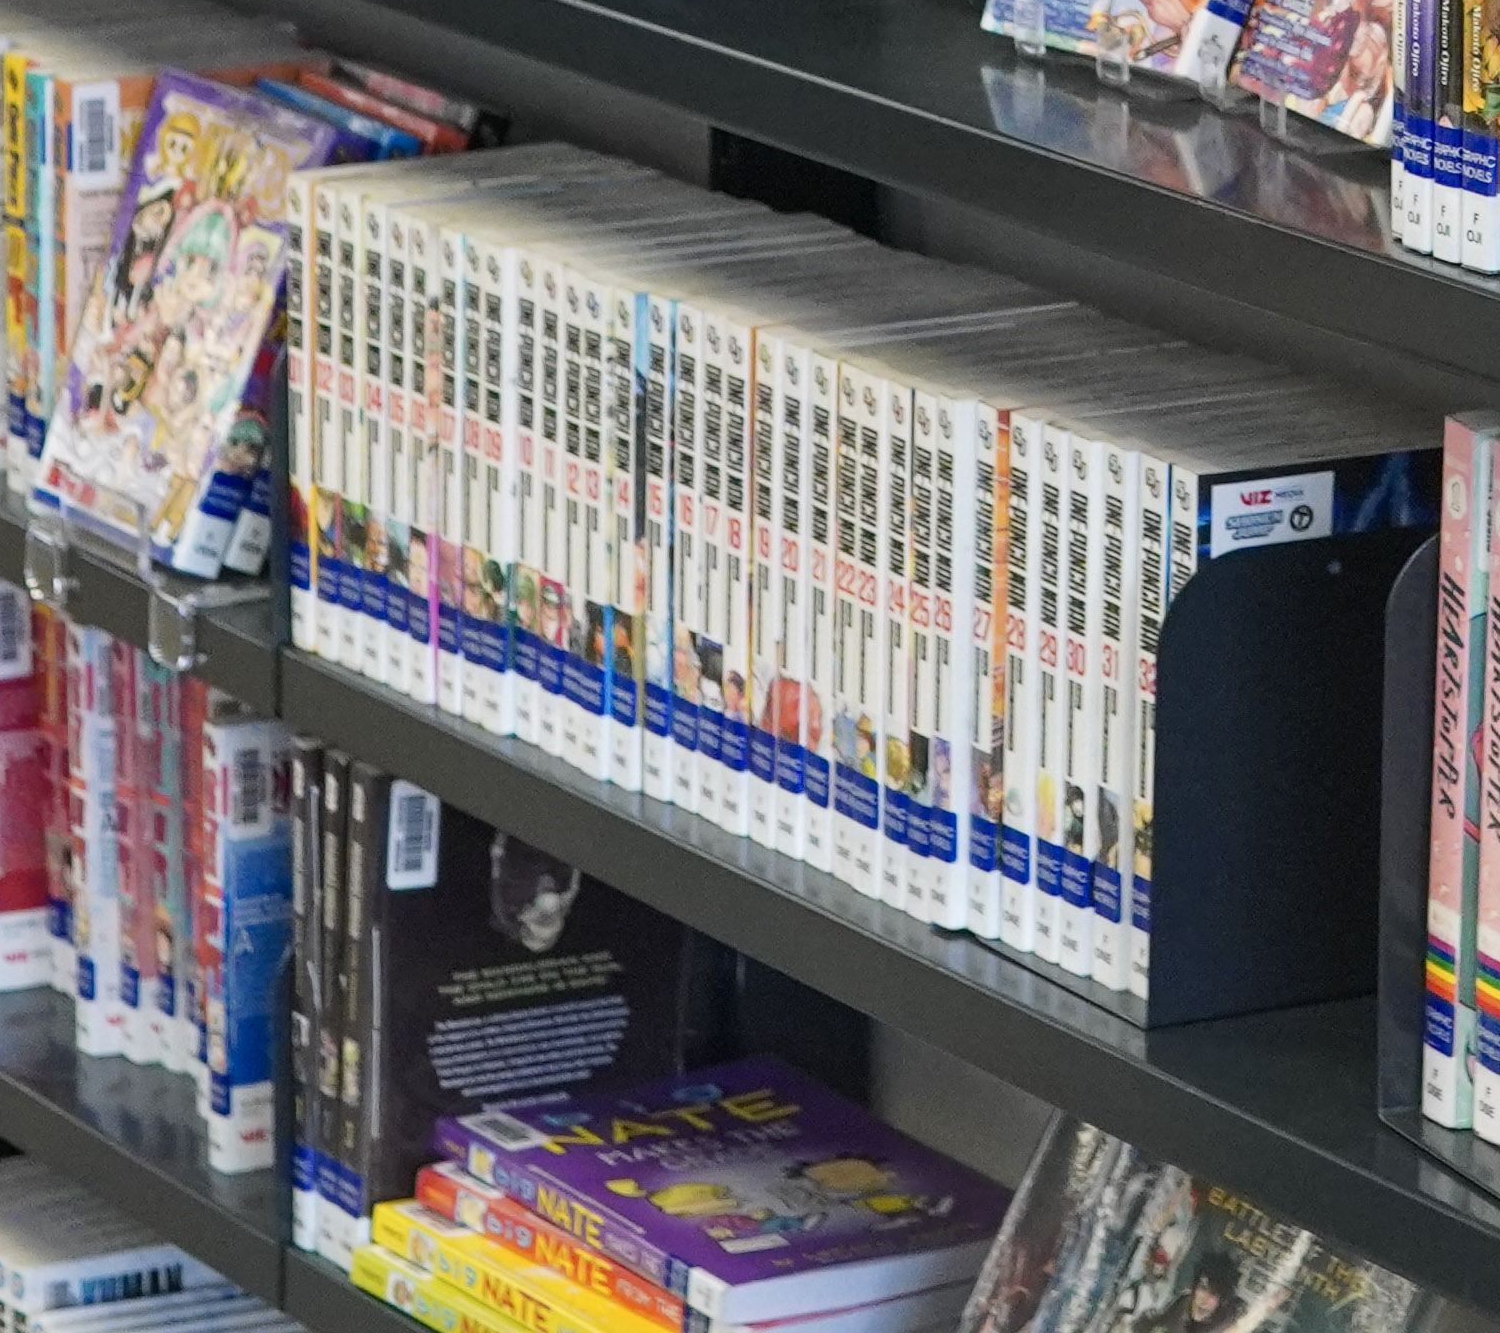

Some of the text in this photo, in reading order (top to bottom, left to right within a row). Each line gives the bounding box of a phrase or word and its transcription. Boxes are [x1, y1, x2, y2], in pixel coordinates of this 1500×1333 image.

[1240, 489, 1272, 506] VIZ
[1066, 641, 1086, 677] 30
[1102, 644, 1120, 679] 31
[542, 1089, 800, 1155] NATE
[534, 1230, 612, 1296] NATE
